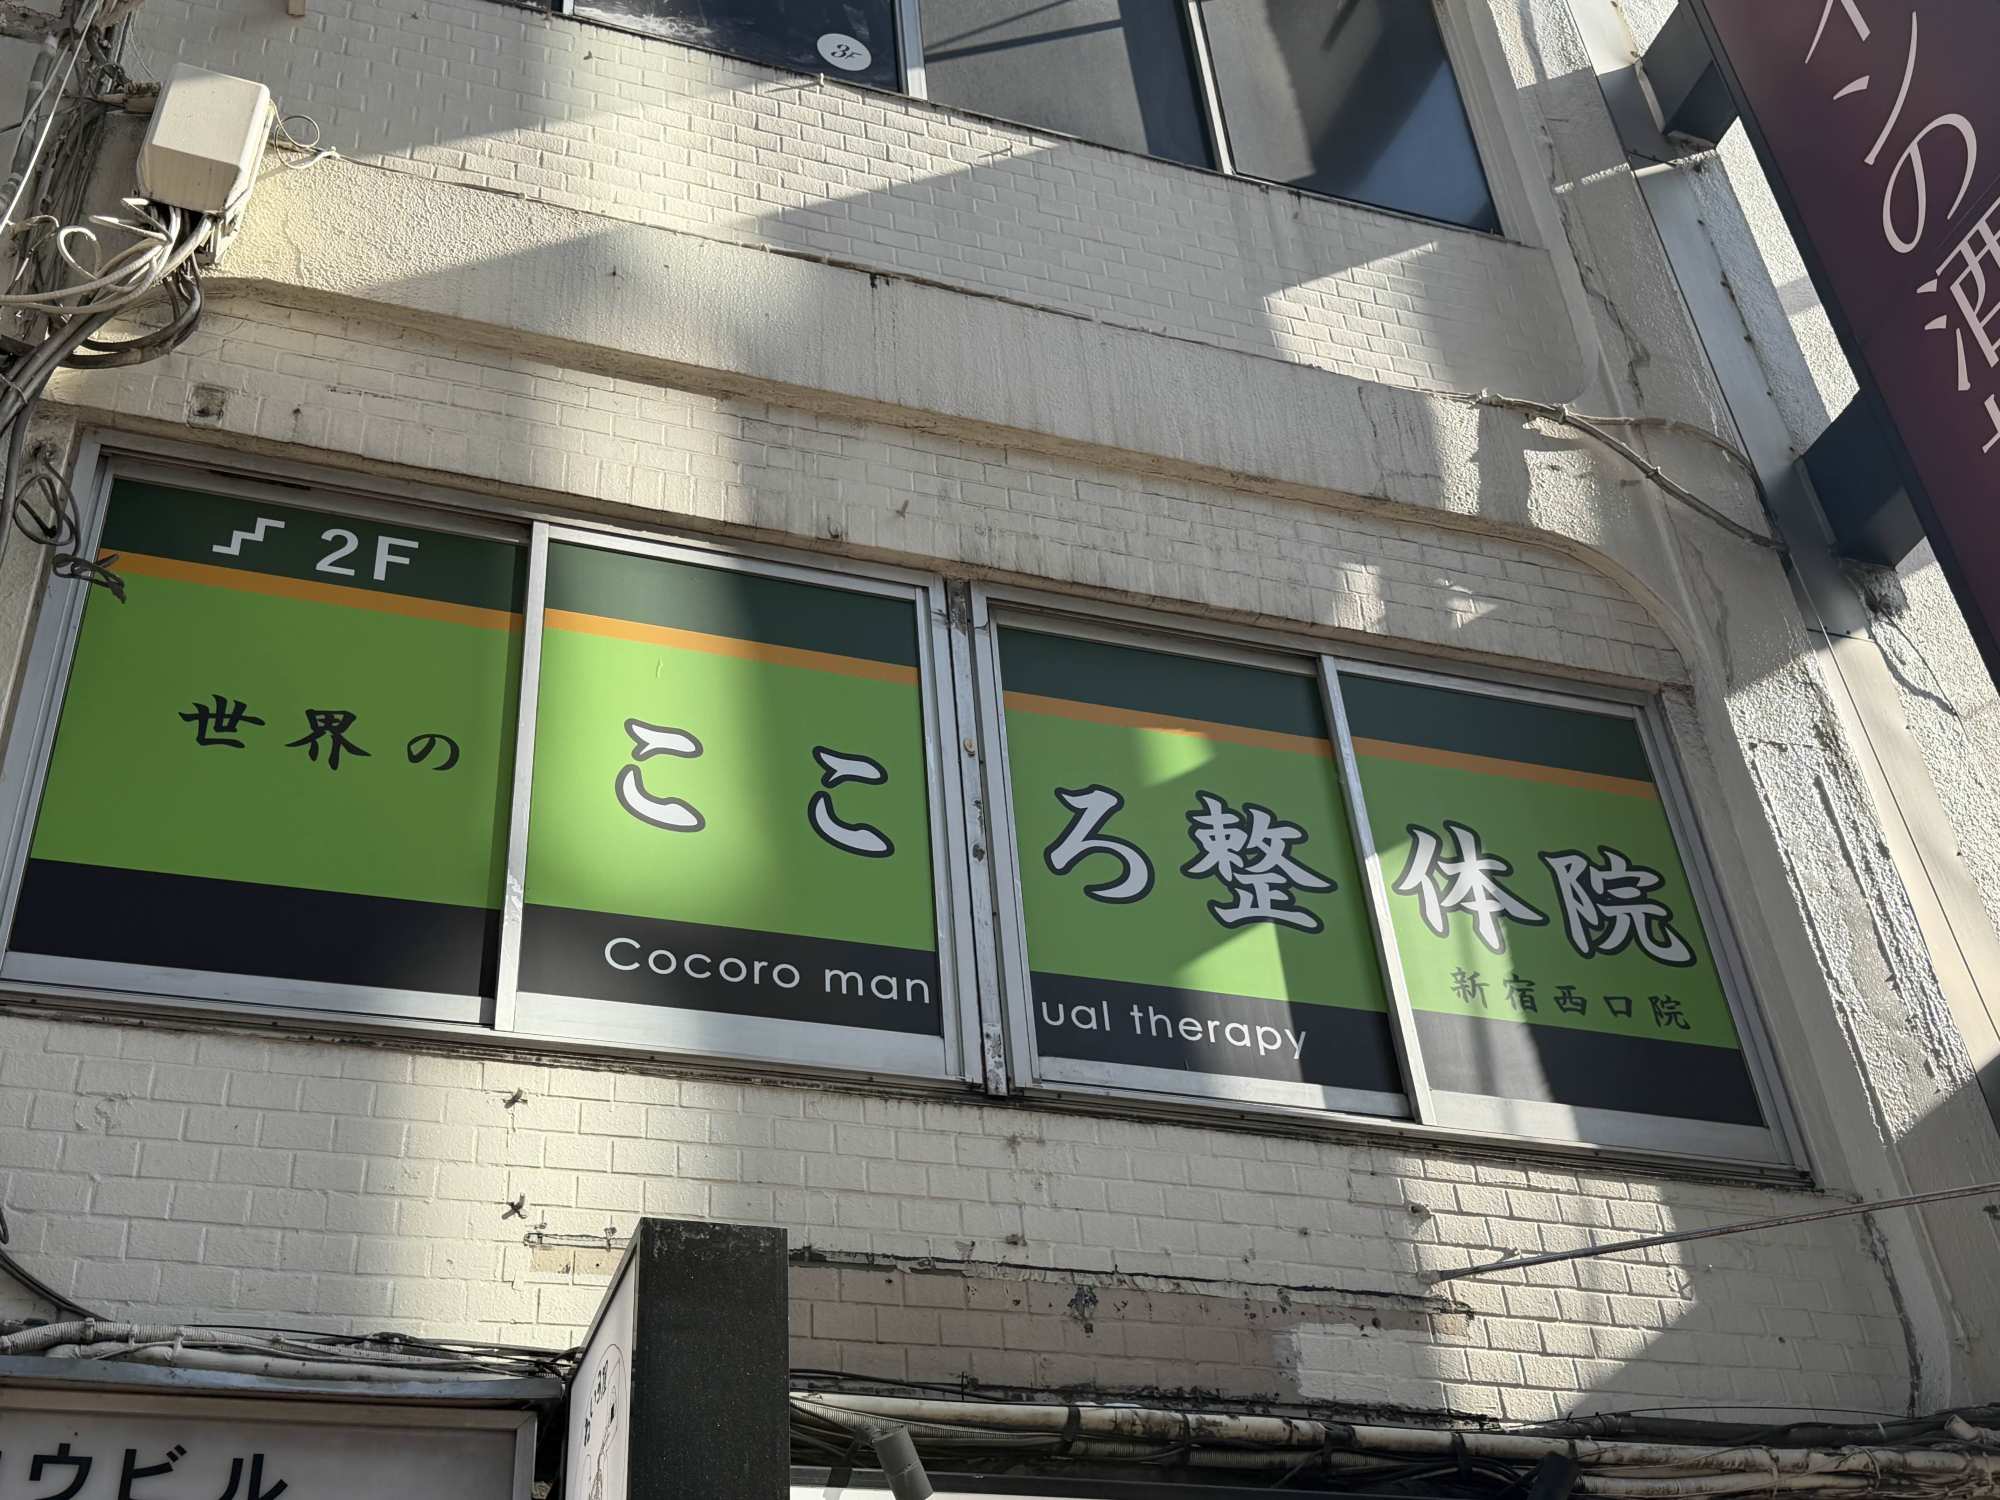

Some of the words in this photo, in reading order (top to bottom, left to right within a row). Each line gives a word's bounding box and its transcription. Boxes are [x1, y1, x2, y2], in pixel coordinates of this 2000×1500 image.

[315, 528, 419, 581] 2F
[178, 694, 460, 771] 世界の
[604, 937, 801, 989] Cocoro
[1129, 1004, 1307, 1060] therapy
[1450, 966, 1691, 1031] 新宿西口院
